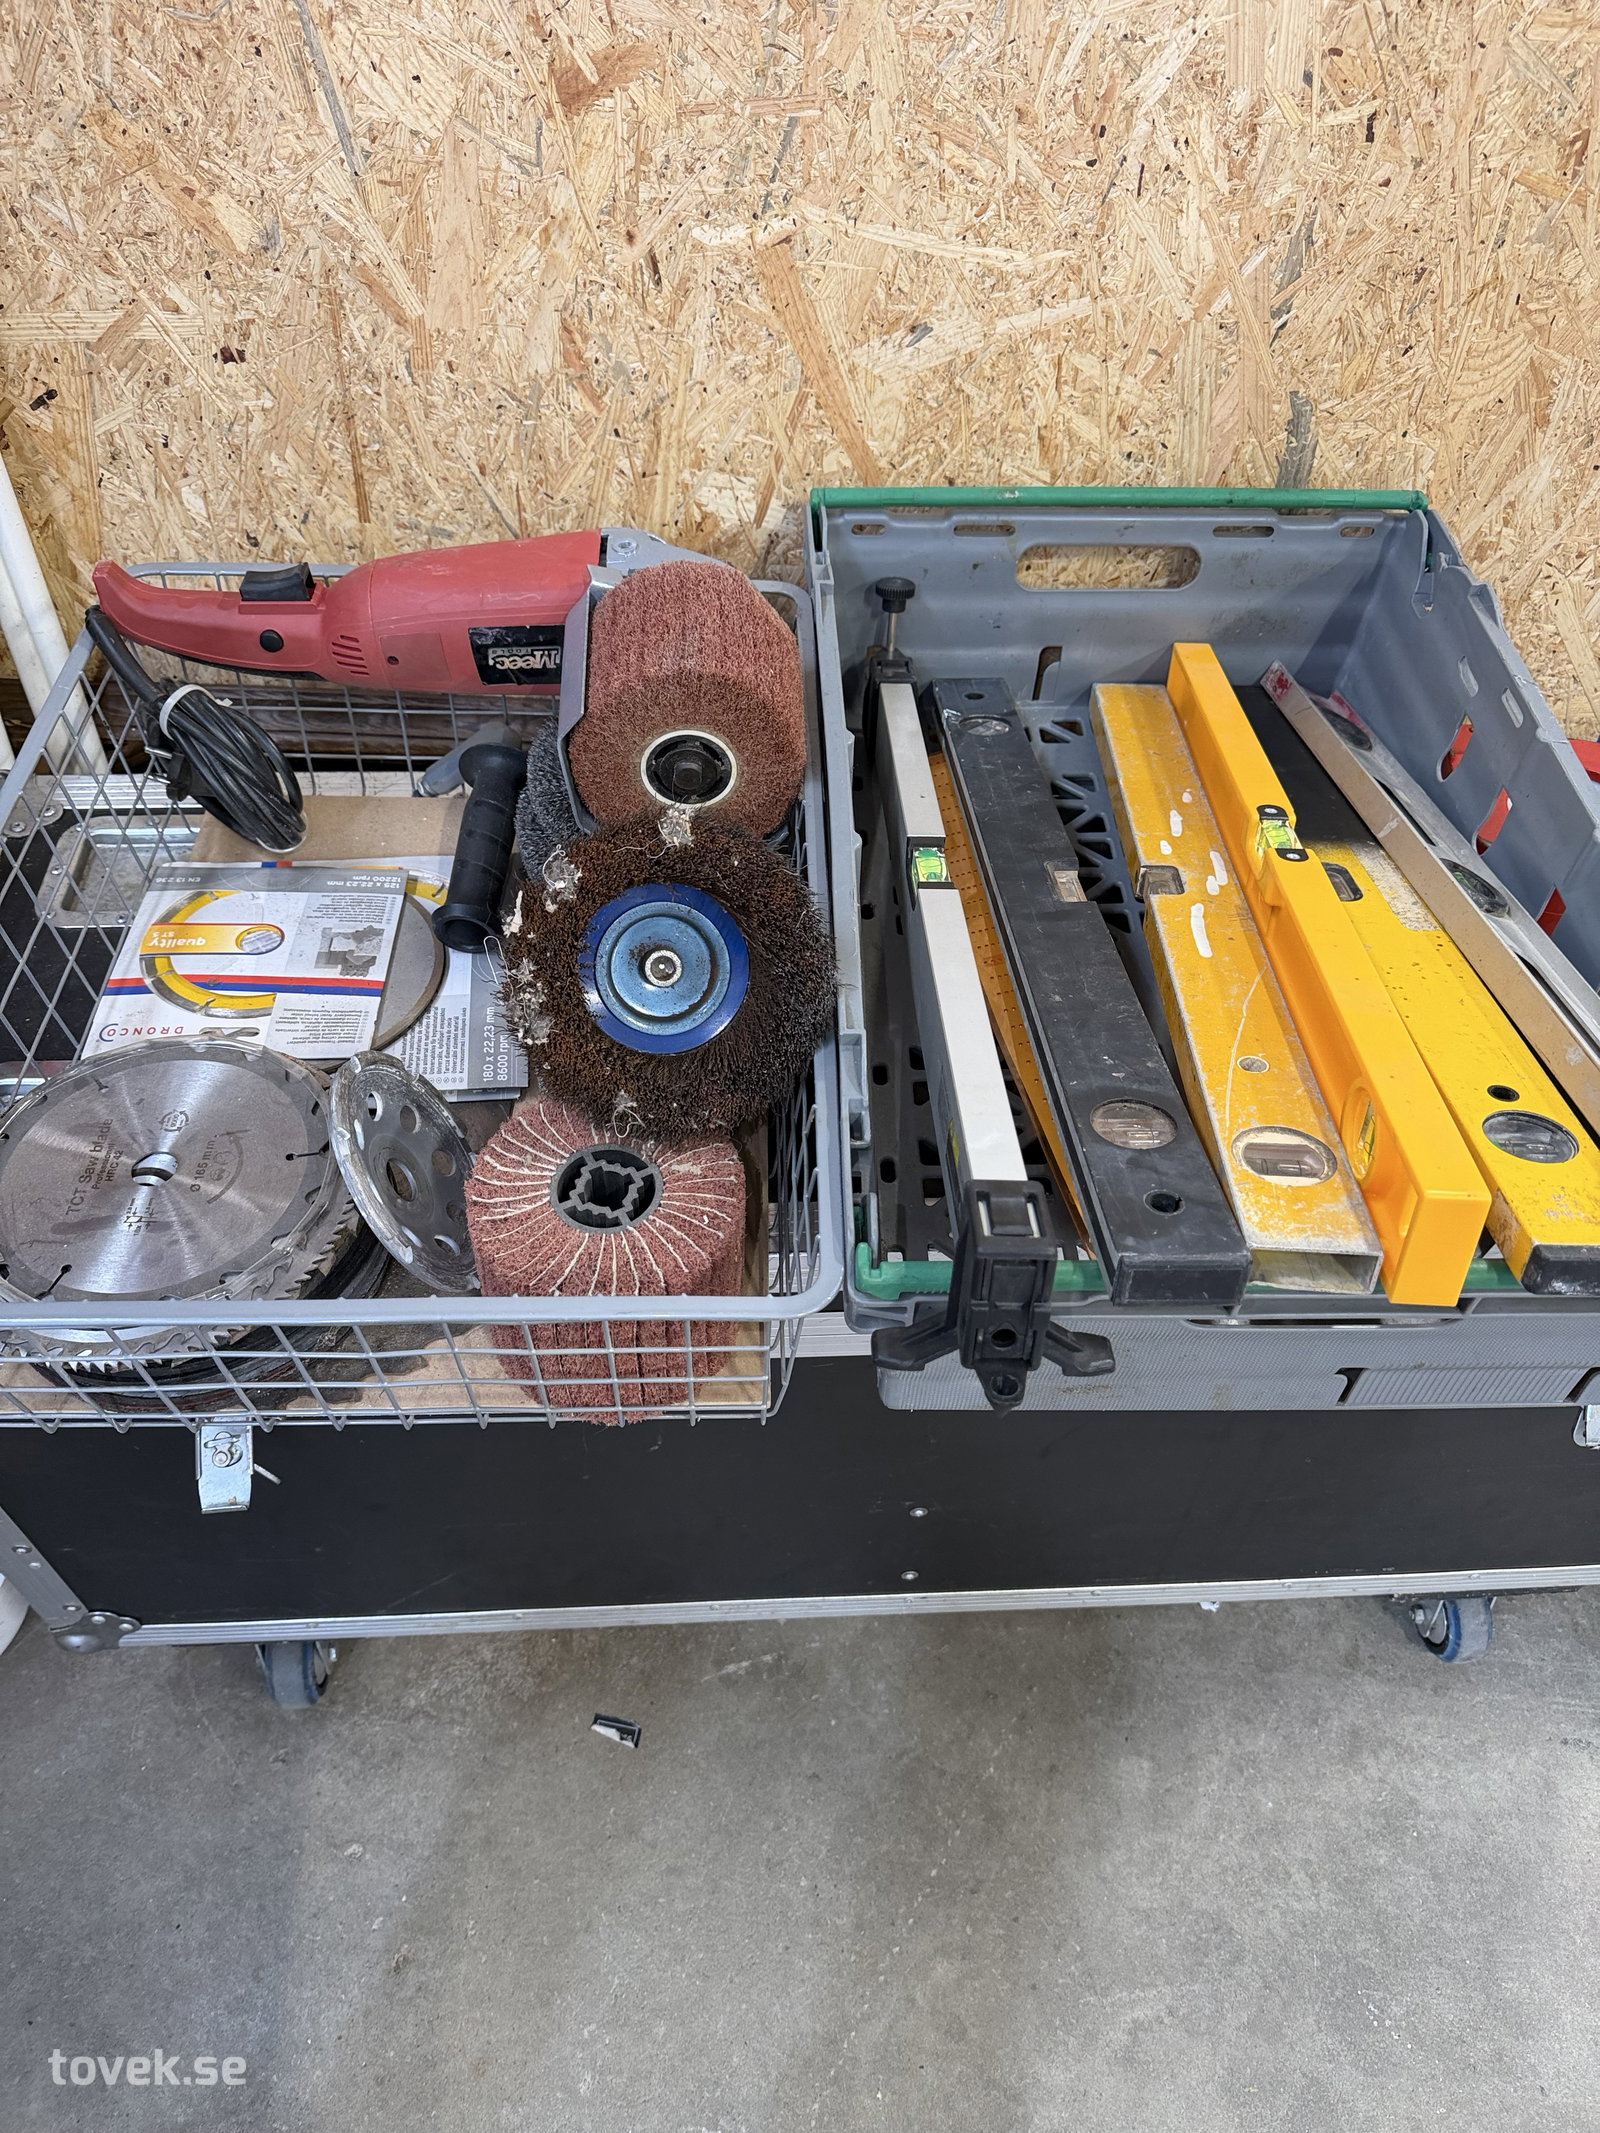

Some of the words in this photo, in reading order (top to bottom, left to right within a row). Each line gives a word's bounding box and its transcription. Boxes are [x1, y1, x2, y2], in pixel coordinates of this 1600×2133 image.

[495, 650, 558, 670] Meec
[147, 936, 206, 949] quality
[486, 1006, 495, 1023] mm
[107, 1026, 184, 1037] DRONCO
[483, 1025, 496, 1053] 22,23
[499, 1034, 510, 1052] rpm
[483, 1064, 494, 1082] 180
[497, 1055, 509, 1081] 8600
[66, 1188, 86, 1215] TCT
[79, 1156, 98, 1185] Saw
[90, 1118, 113, 1153] blade
[92, 1144, 115, 1189] Professional
[105, 1163, 119, 1181] HRC
[114, 1150, 123, 1160] 42
[195, 1163, 207, 1180] 165
[202, 1141, 215, 1160] mm
